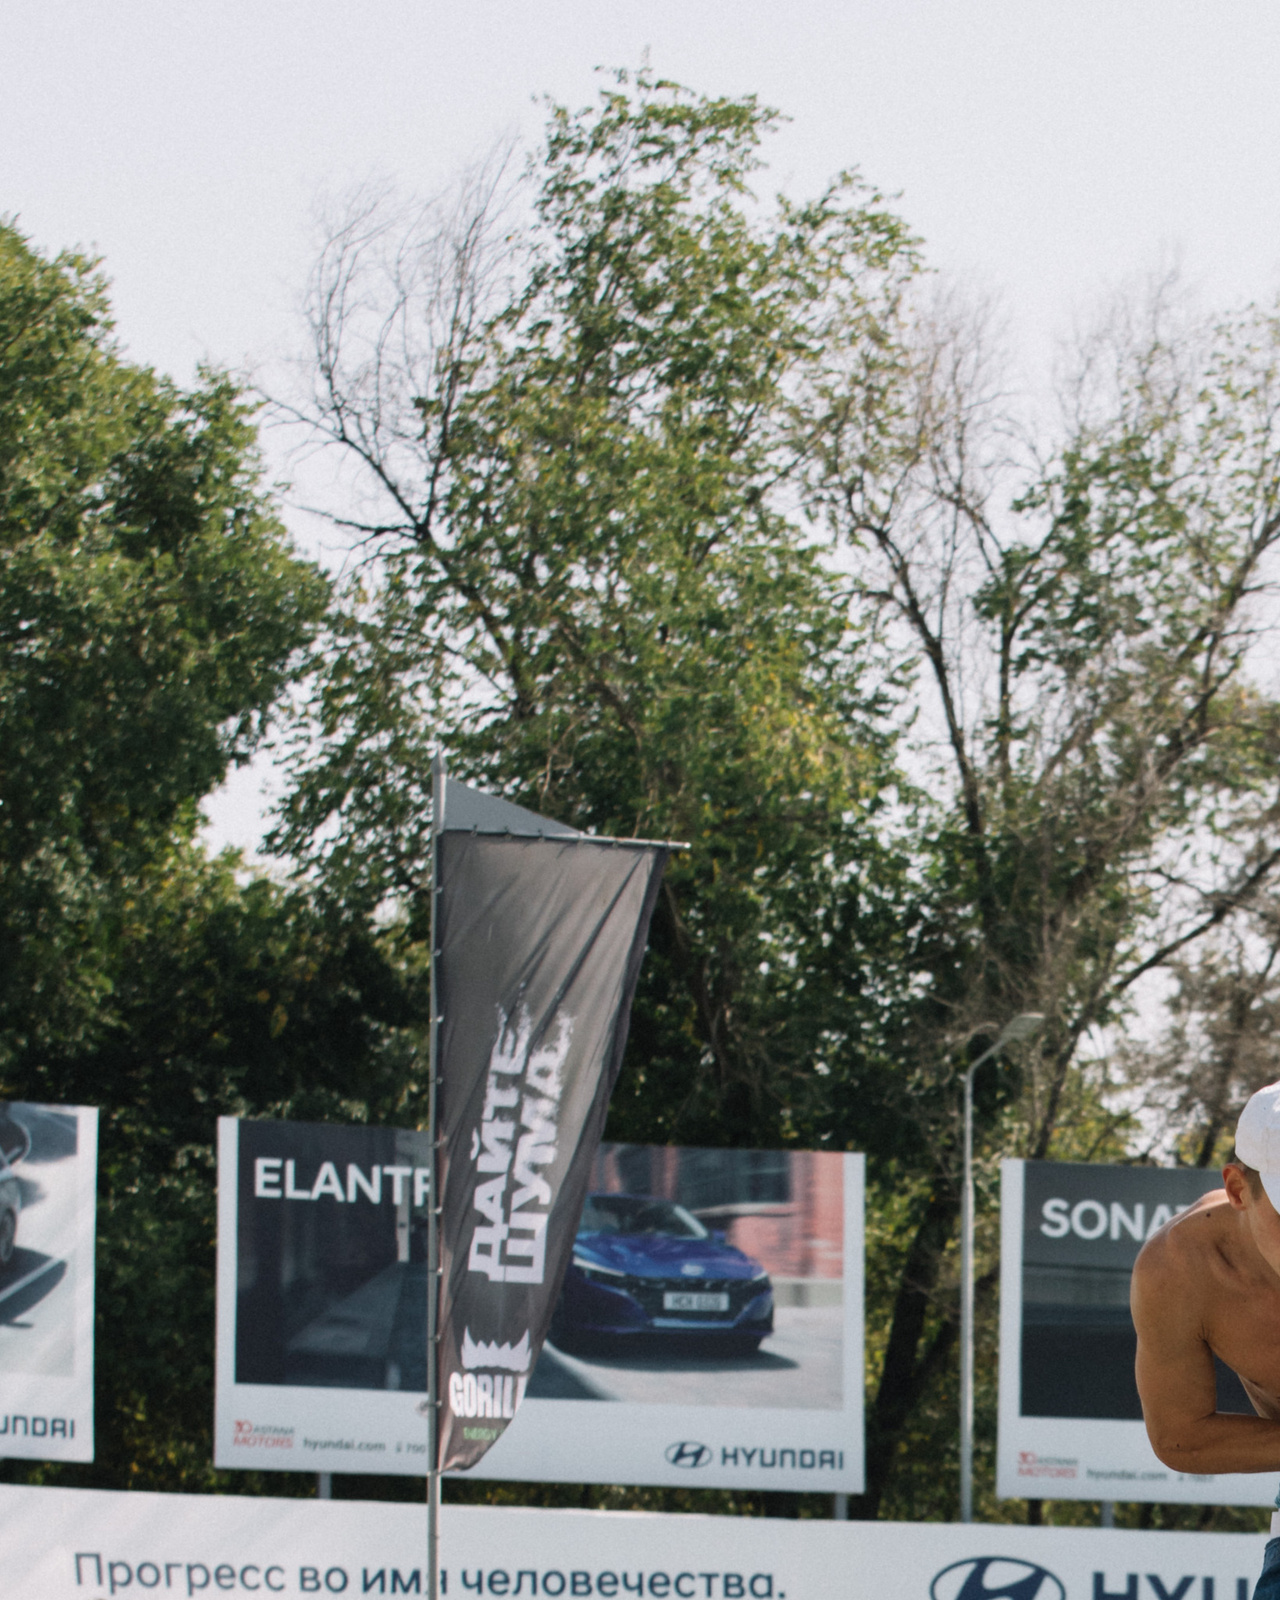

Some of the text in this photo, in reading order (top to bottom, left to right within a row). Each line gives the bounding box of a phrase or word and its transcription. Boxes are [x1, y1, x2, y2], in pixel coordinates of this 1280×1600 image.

[468, 1002, 531, 1282] ДАЙТЕ
[503, 1008, 576, 1284] ШУМА
[1040, 1198, 1190, 1241] SONA
[303, 1437, 386, 1452] hyundai.com
[720, 1446, 844, 1471] HYUNDAI
[74, 1551, 286, 1598] Прогресс
[299, 1565, 349, 1594] во
[461, 1568, 786, 1600] человечества.
